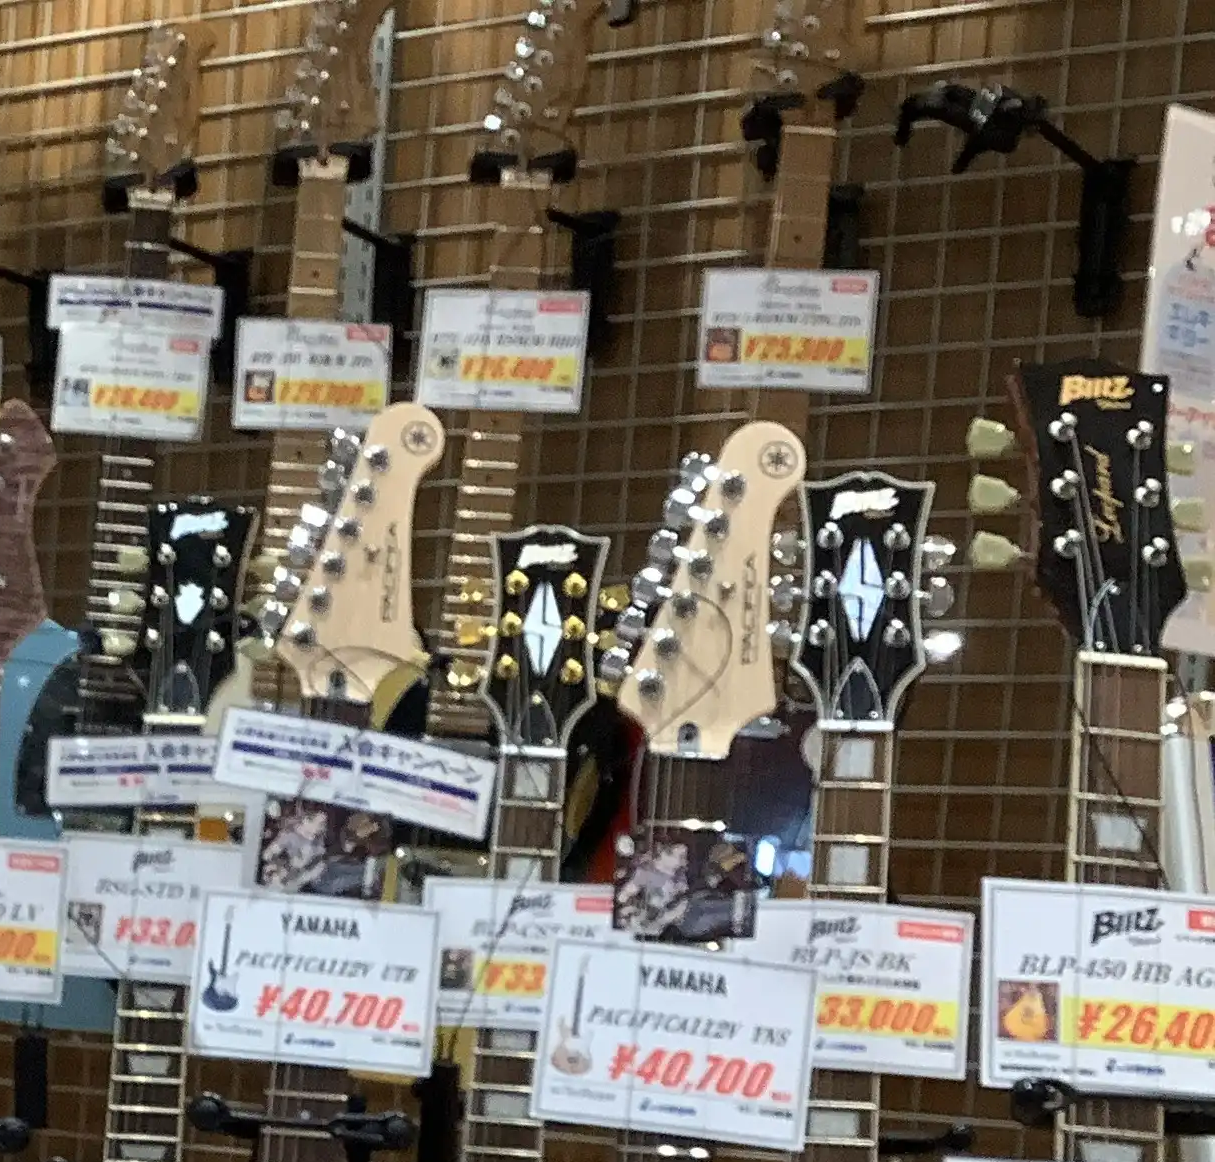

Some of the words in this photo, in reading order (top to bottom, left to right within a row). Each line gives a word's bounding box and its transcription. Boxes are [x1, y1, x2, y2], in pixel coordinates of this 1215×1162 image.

[281, 911, 361, 941] YAMAHA
[639, 963, 729, 998] YAMAHA
[255, 983, 405, 1031] ¥40,700
[817, 993, 941, 1034] 33,000
[1078, 1000, 1215, 1050] ¥26,40
[607, 1042, 776, 1098] ¥40,700
